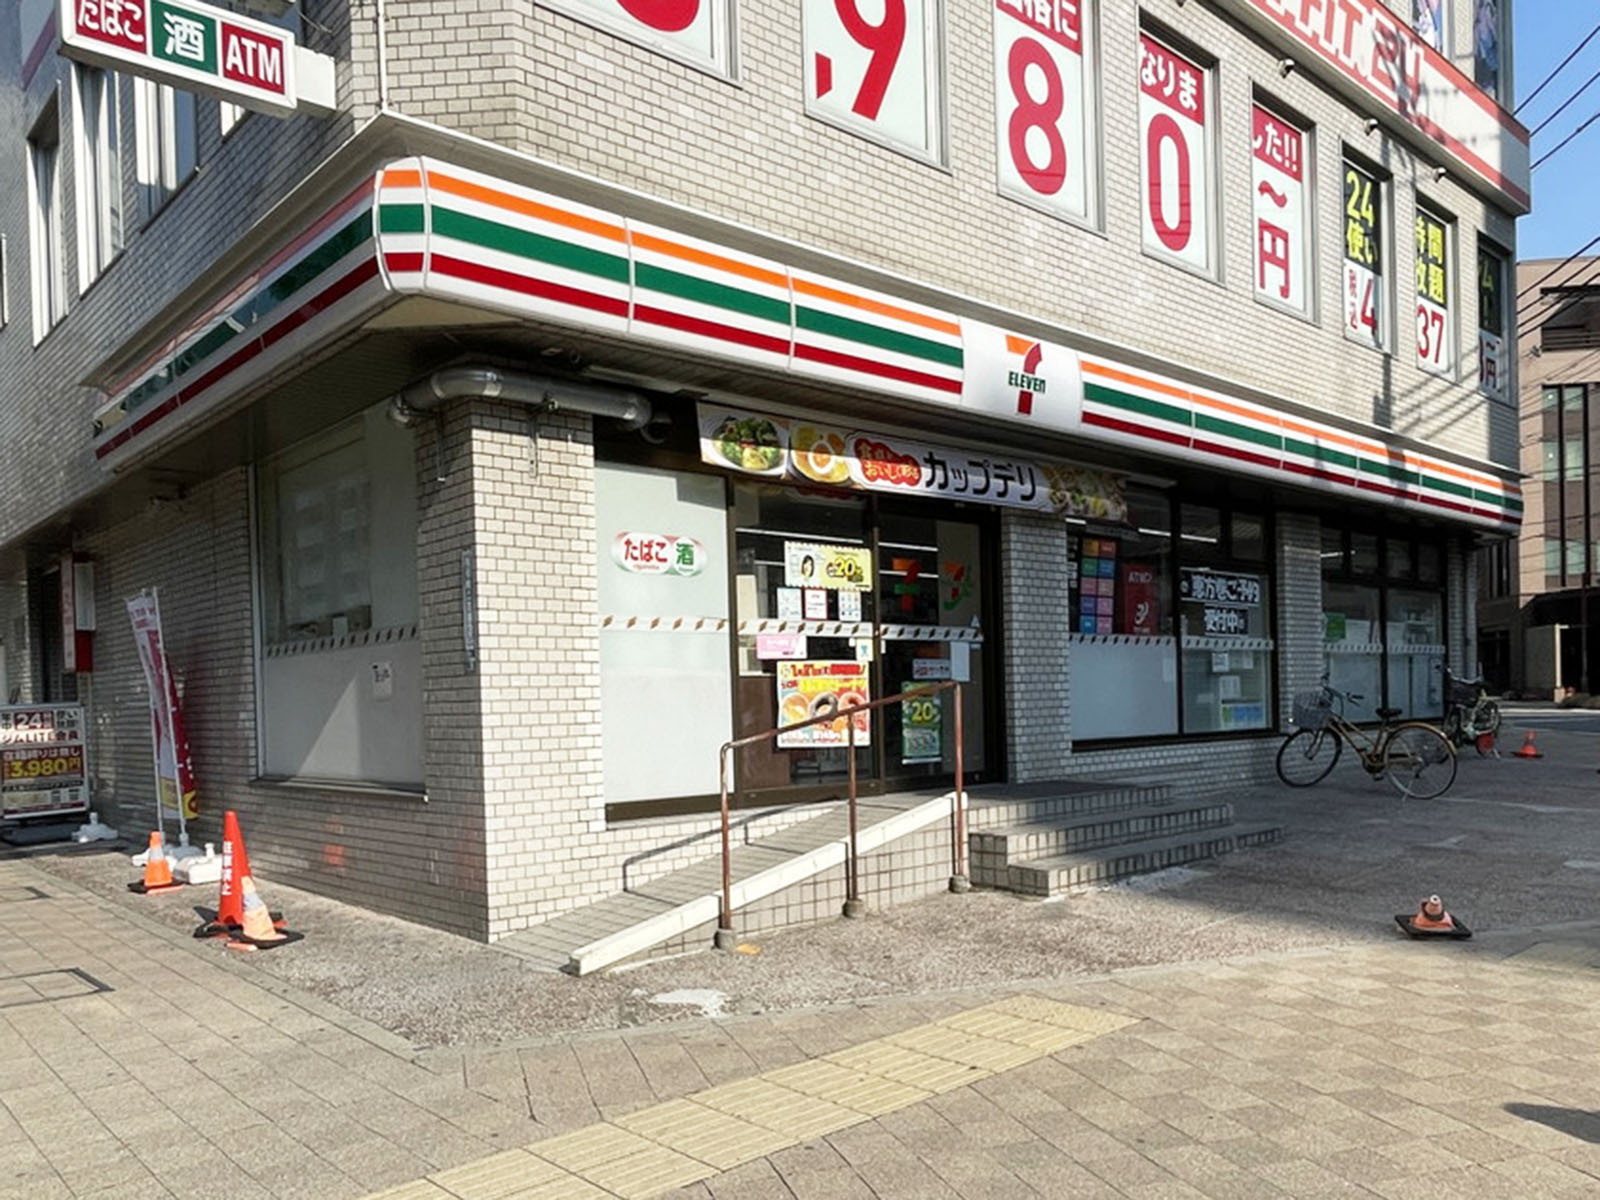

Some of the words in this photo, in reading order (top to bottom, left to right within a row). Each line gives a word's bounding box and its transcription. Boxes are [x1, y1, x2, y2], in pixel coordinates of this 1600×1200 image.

[163, 12, 205, 62] 酒
[225, 34, 282, 86] ATM
[1008, 37, 1067, 195] 8
[1147, 113, 1191, 251] 0
[923, 451, 1036, 501] カップデリ
[625, 538, 668, 563] たばこ
[676, 542, 694, 565] 酒
[17, 714, 41, 730] 24
